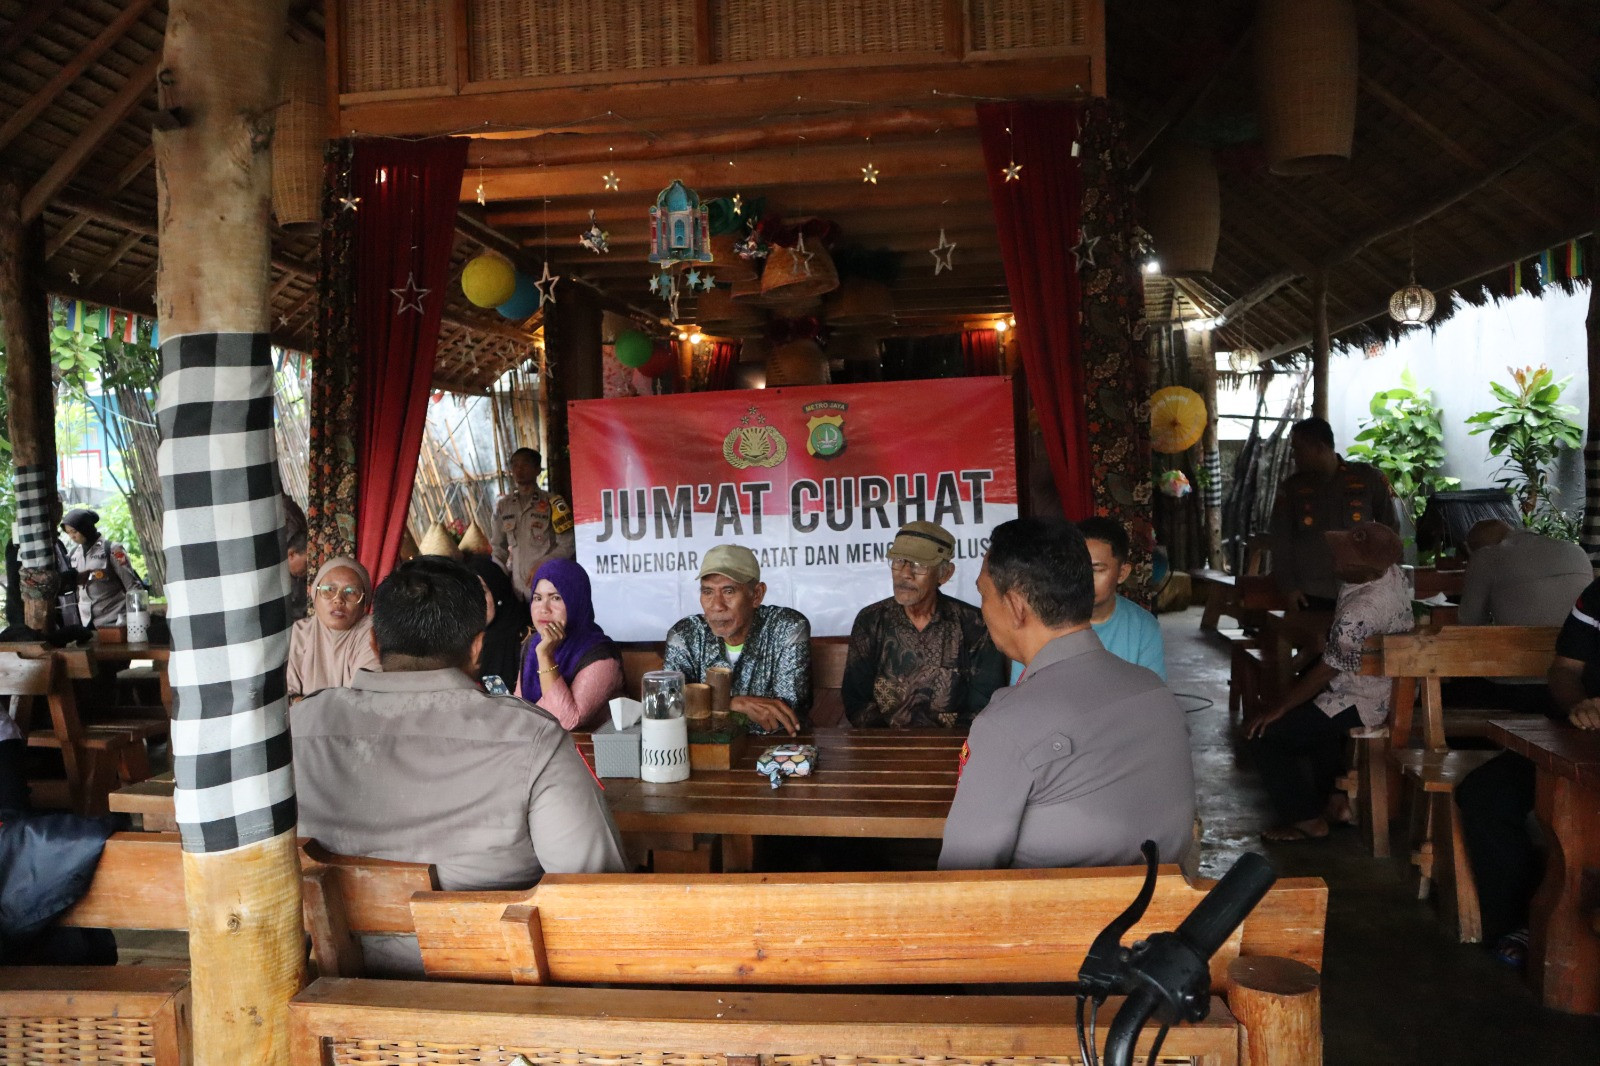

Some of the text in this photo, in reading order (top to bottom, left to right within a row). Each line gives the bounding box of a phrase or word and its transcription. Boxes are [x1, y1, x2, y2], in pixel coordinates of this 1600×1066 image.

[805, 402, 845, 411] METRO JAYA
[596, 470, 993, 542] JUM'AT CURHAT
[596, 551, 698, 574] MENDENGAR
[751, 546, 798, 568] ATAT
[805, 545, 839, 566] DAN
[957, 538, 992, 559] LUS
